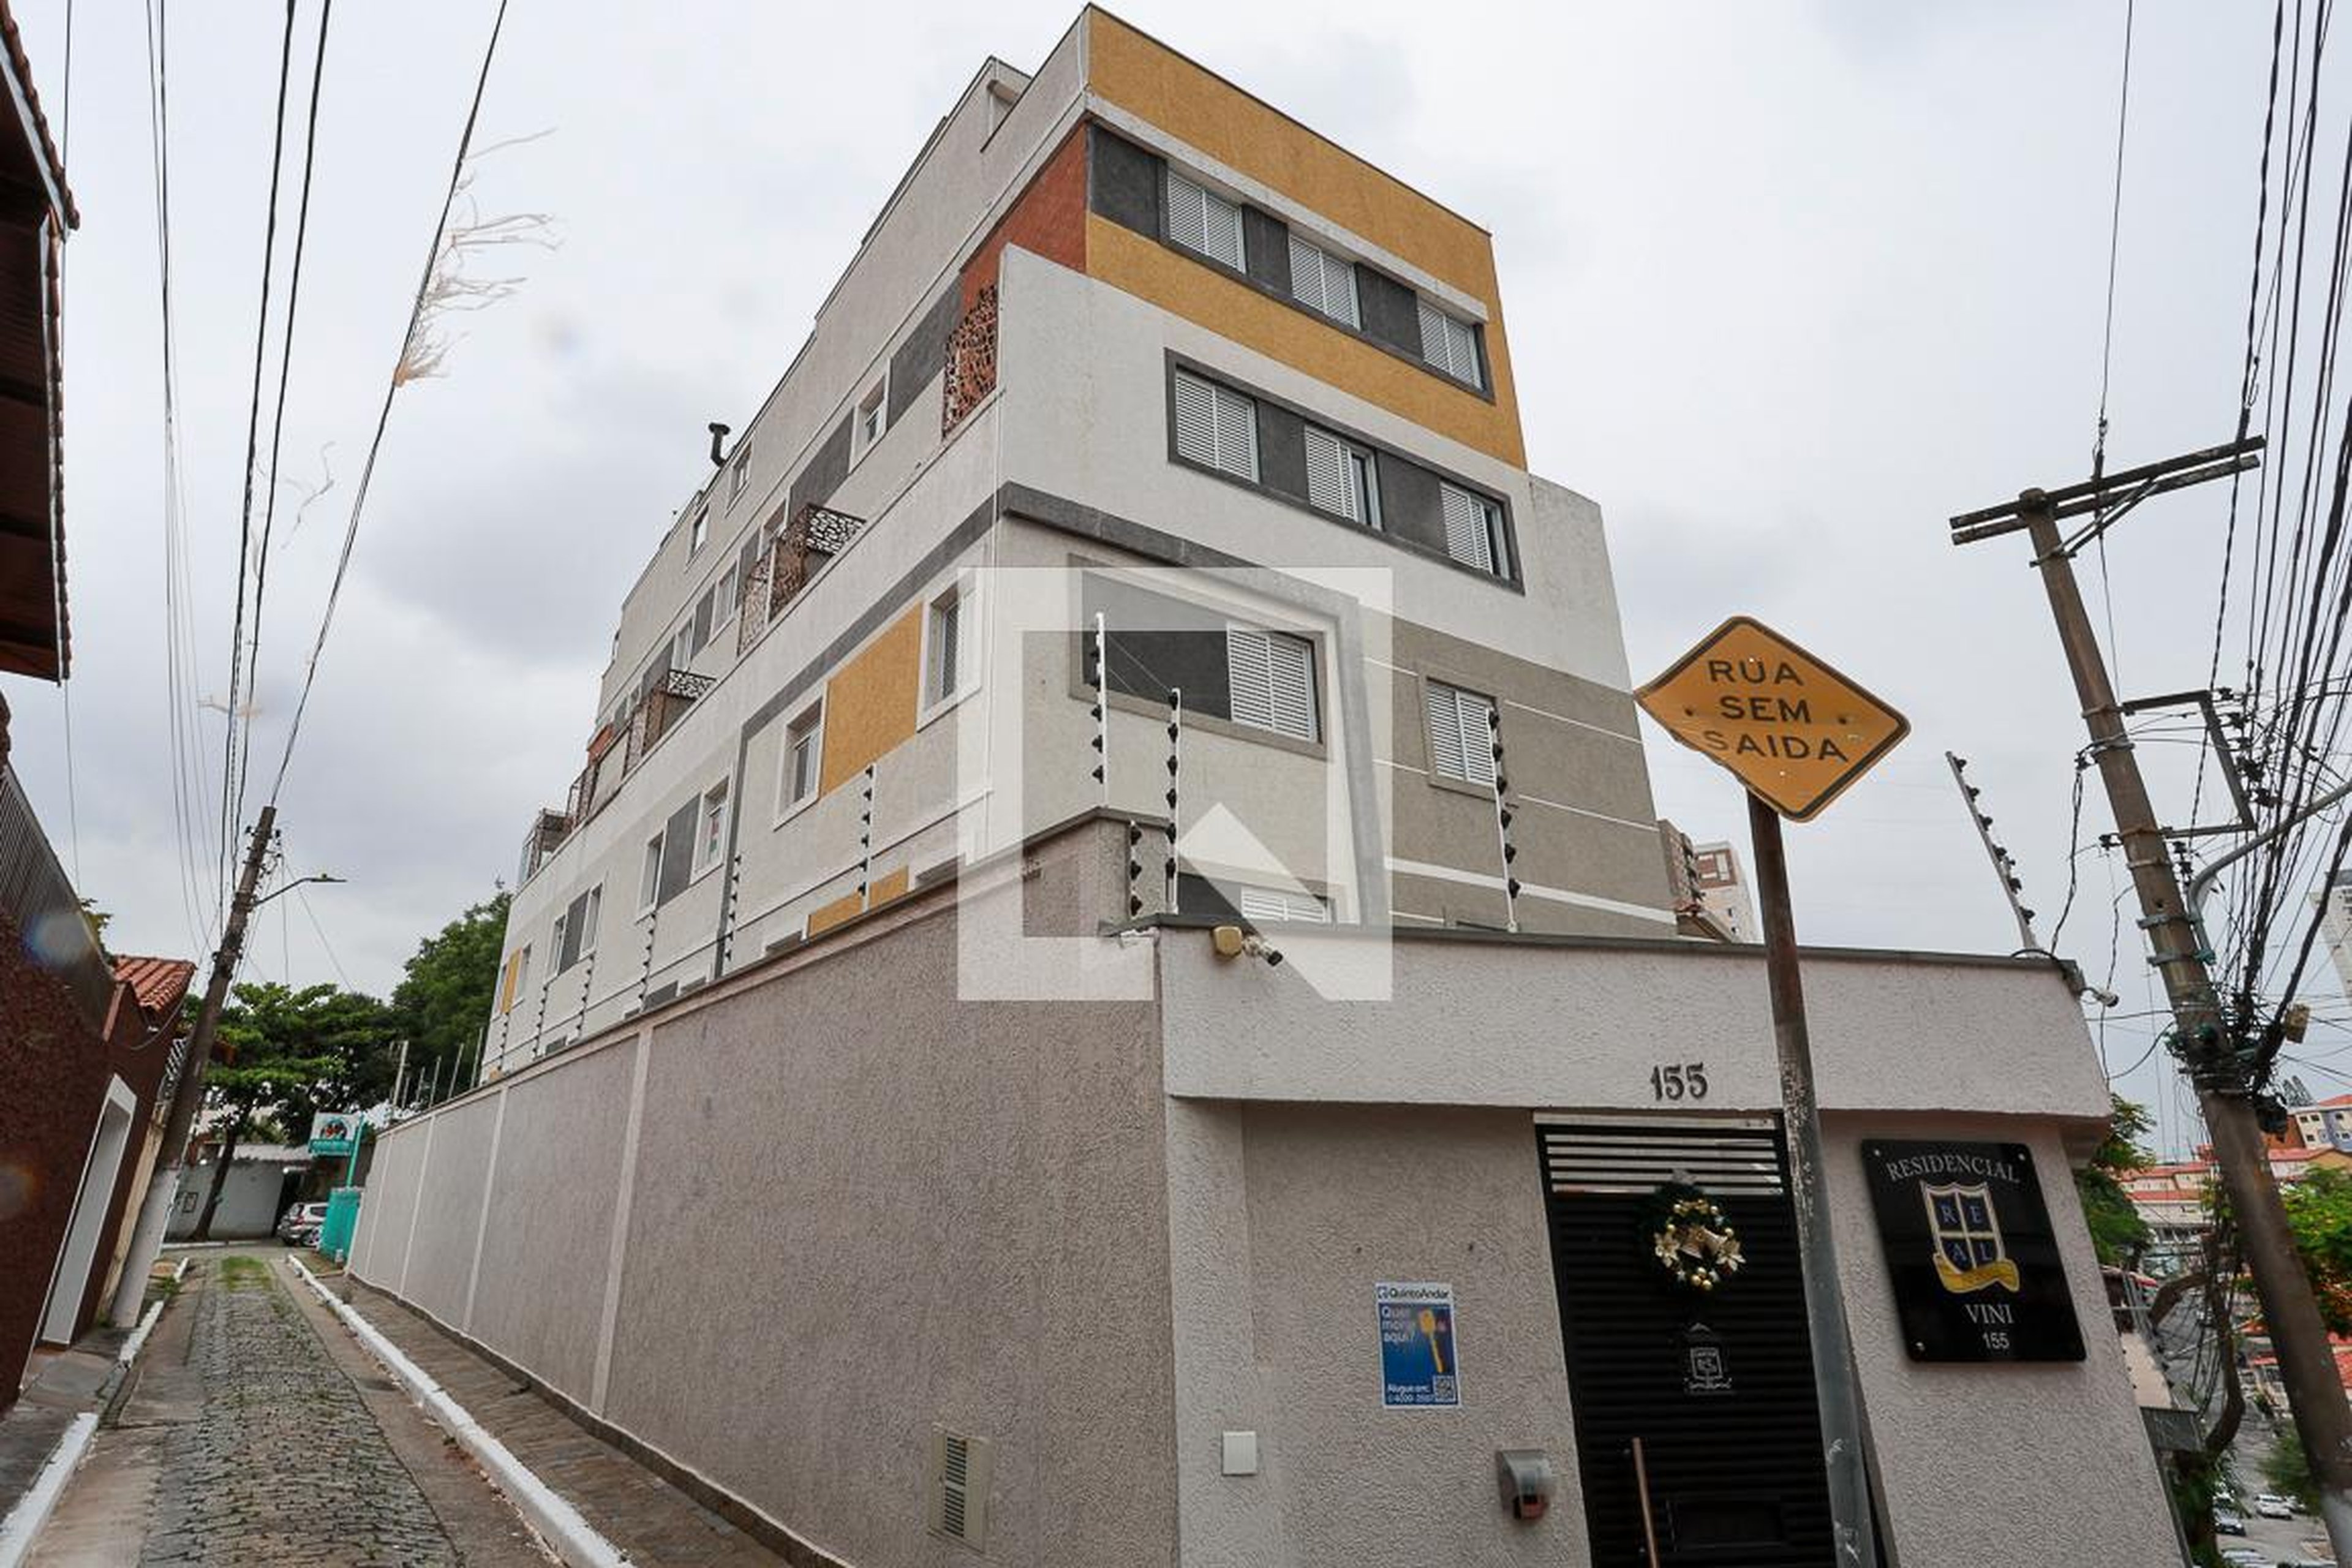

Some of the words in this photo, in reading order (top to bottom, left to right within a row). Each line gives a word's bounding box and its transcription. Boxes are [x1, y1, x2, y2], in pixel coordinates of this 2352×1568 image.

[1708, 659, 1805, 687] RUA
[1720, 695, 1812, 724] SEM
[1703, 731, 1849, 763] SAIDA
[1650, 1061, 1708, 1102] 155
[1886, 1154, 2020, 1183] RESIDENCIAL
[1940, 1205, 1958, 1224] R
[1969, 1205, 1983, 1224] E
[1965, 1303, 2015, 1324] VINI
[1982, 1332, 2010, 1350] 155
